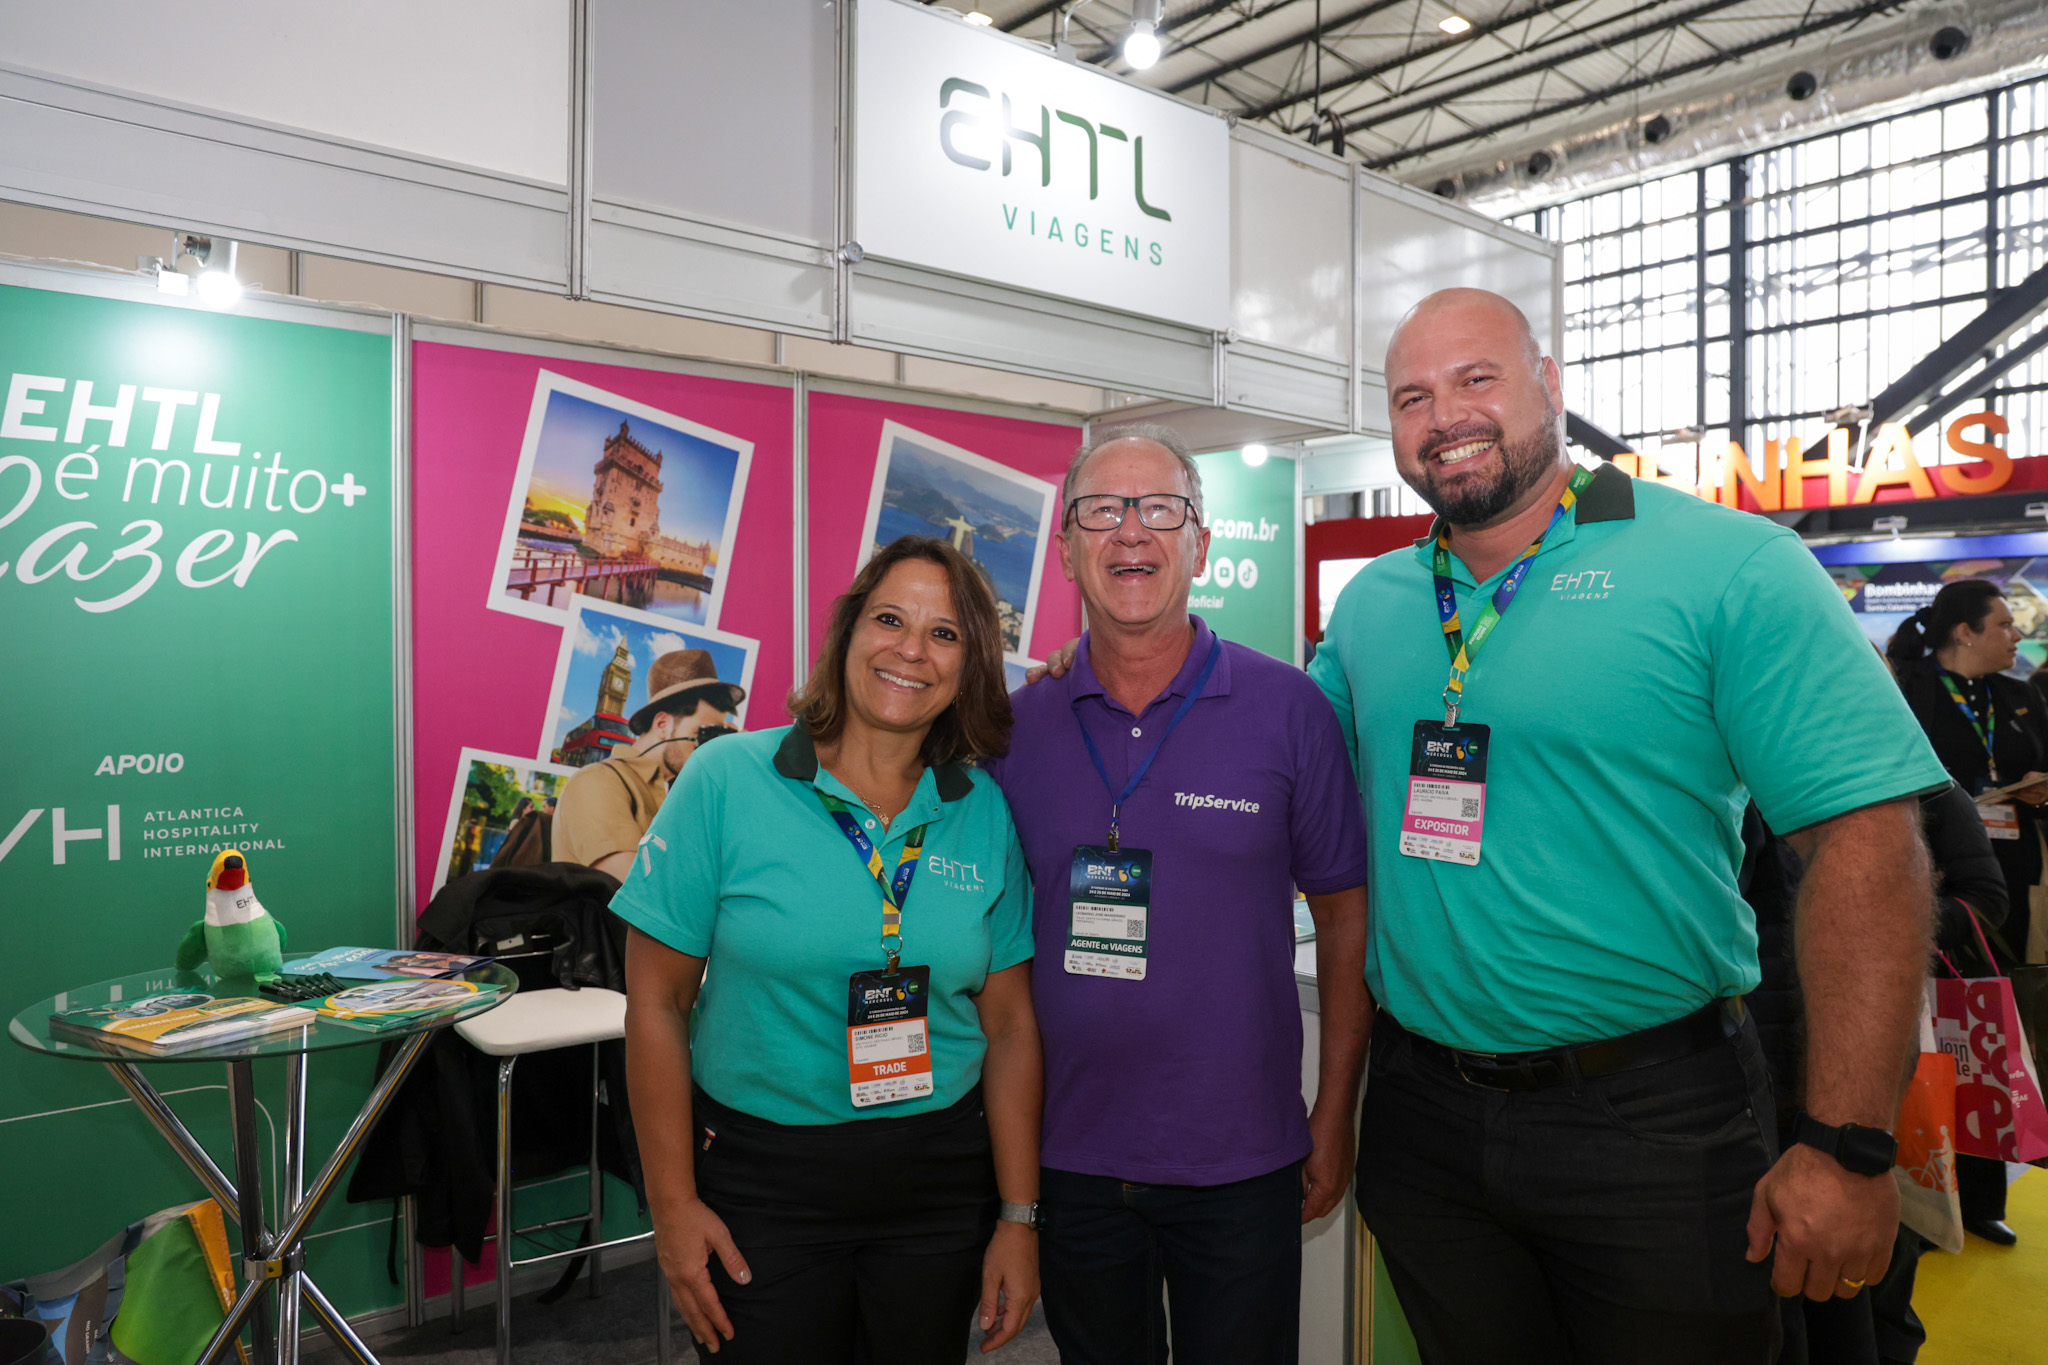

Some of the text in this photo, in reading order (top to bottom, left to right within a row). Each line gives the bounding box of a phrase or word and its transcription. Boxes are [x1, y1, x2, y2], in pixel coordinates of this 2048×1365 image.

[940, 77, 1172, 222] EHTL
[1003, 203, 1162, 266] VIAGENS
[0, 373, 241, 456] EHTL
[55, 444, 101, 500] é
[1550, 570, 1616, 591] EHTL
[94, 752, 185, 776] APOIO
[1174, 792, 1260, 814] TripService
[144, 806, 244, 822] ATLANTICA
[144, 823, 259, 840] HOSPITALITY
[1414, 818, 1469, 836] EXPOSITOR
[144, 838, 286, 858] INTERNATIONAL
[929, 856, 984, 883] EHTL
[1071, 939, 1100, 950] AGENTE
[1110, 942, 1143, 954] VIAGENS
[873, 1062, 907, 1076] TRADE
